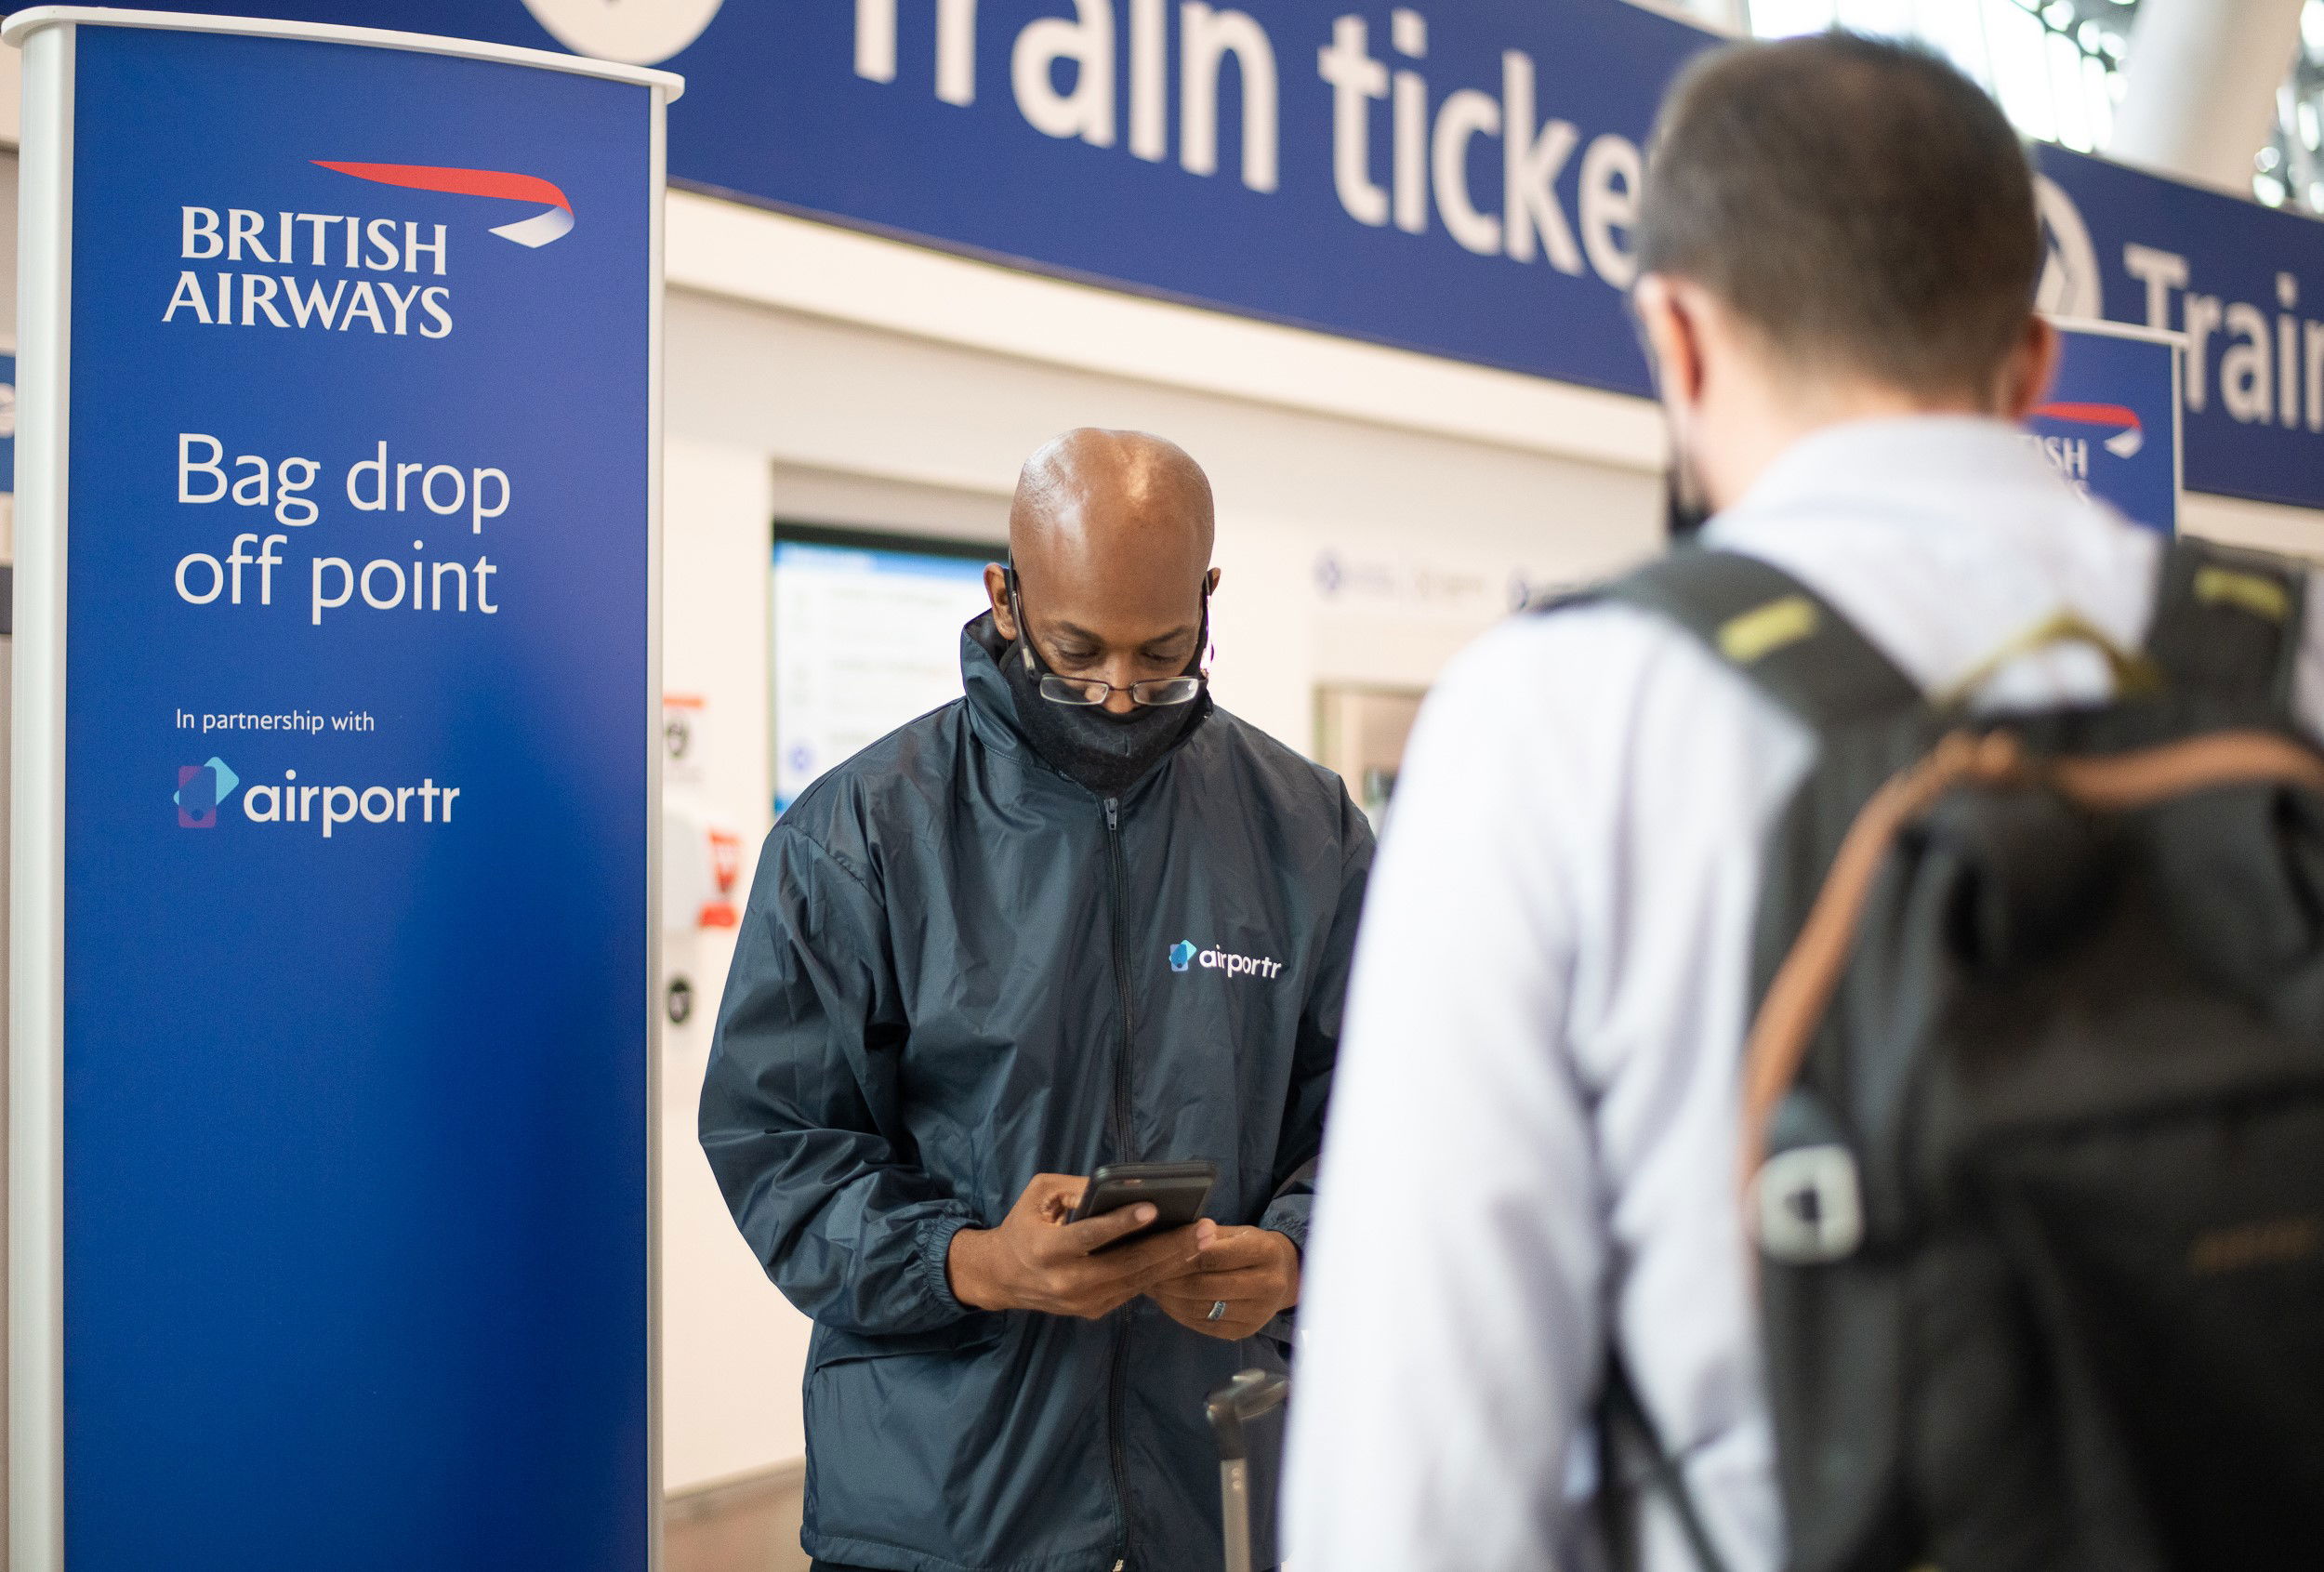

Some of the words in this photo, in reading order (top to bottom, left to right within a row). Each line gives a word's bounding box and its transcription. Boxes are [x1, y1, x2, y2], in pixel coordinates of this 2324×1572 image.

[180, 205, 448, 276] BRITISH
[162, 270, 453, 339] AIRWAYS
[178, 432, 322, 527] Bag
[346, 440, 510, 535] drop
[175, 533, 288, 605] off
[311, 539, 498, 626] point
[176, 708, 195, 730] In
[202, 708, 324, 735] partnership
[330, 709, 376, 732] with
[243, 769, 460, 839] airportr
[1198, 944, 1283, 979] airportr
